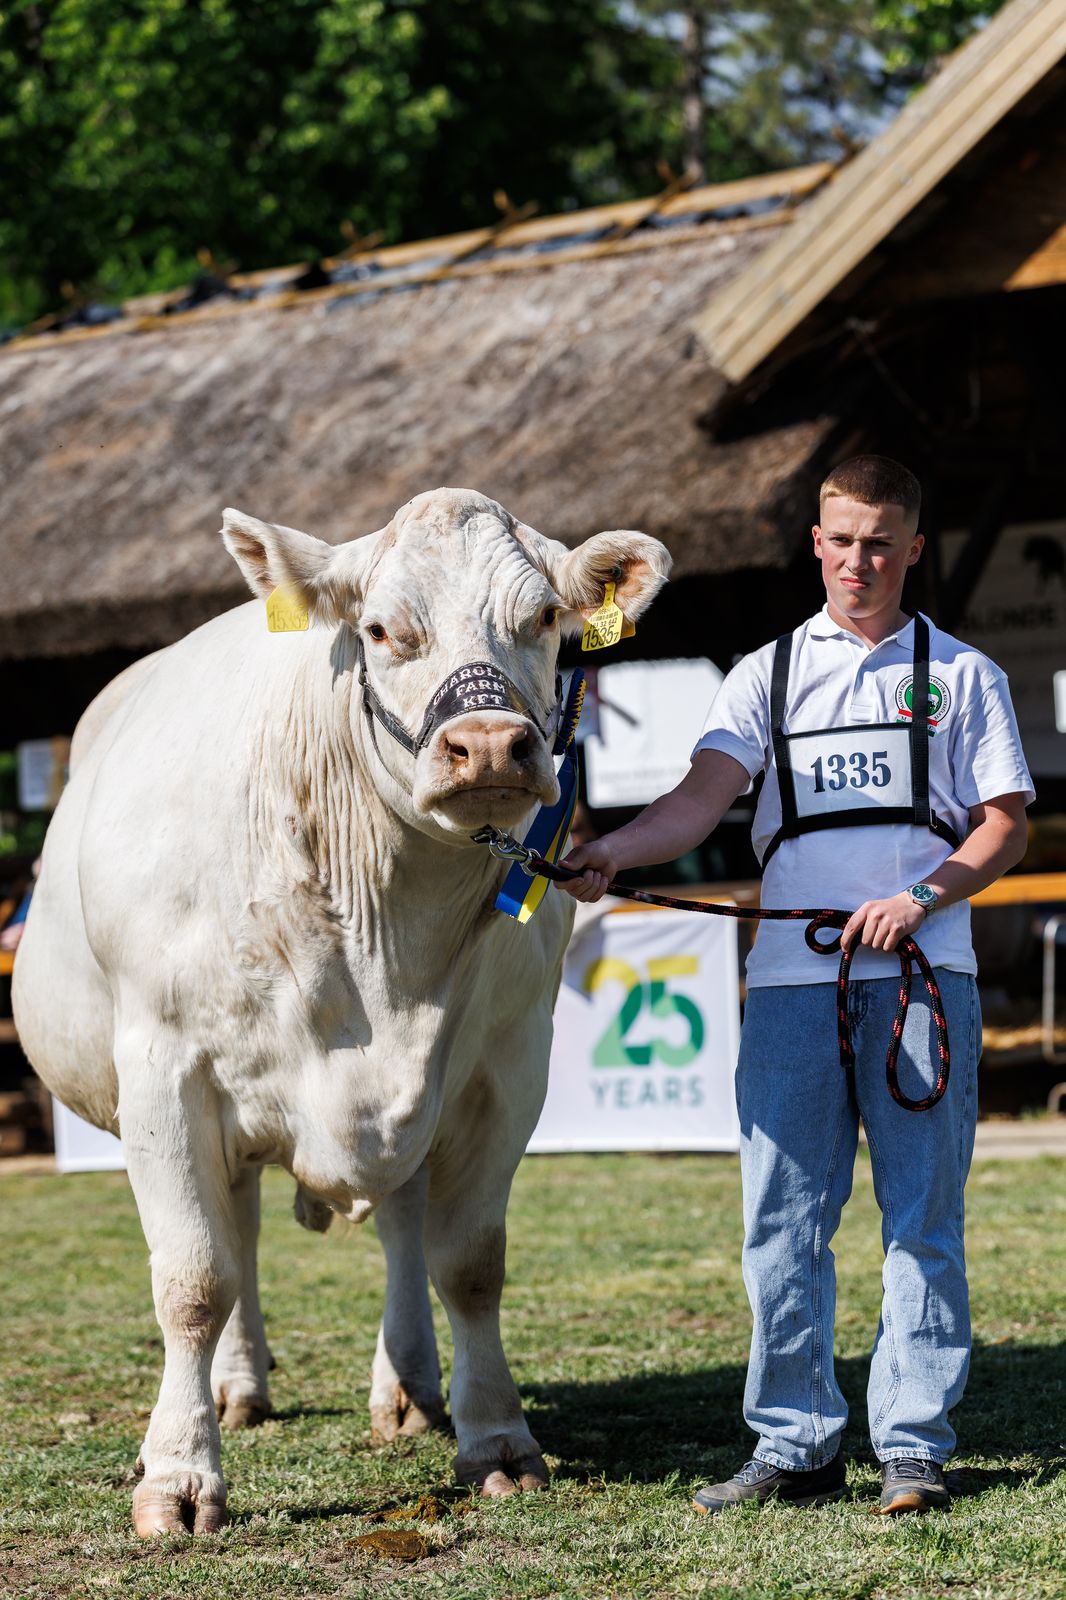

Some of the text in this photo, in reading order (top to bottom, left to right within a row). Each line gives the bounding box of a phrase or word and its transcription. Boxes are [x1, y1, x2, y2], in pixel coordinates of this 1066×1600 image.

[456, 679, 506, 698] FARM
[463, 693, 503, 708] KFT
[810, 750, 892, 794] 1335
[583, 954, 705, 1069] 25
[590, 1073, 705, 1109] YEARS
